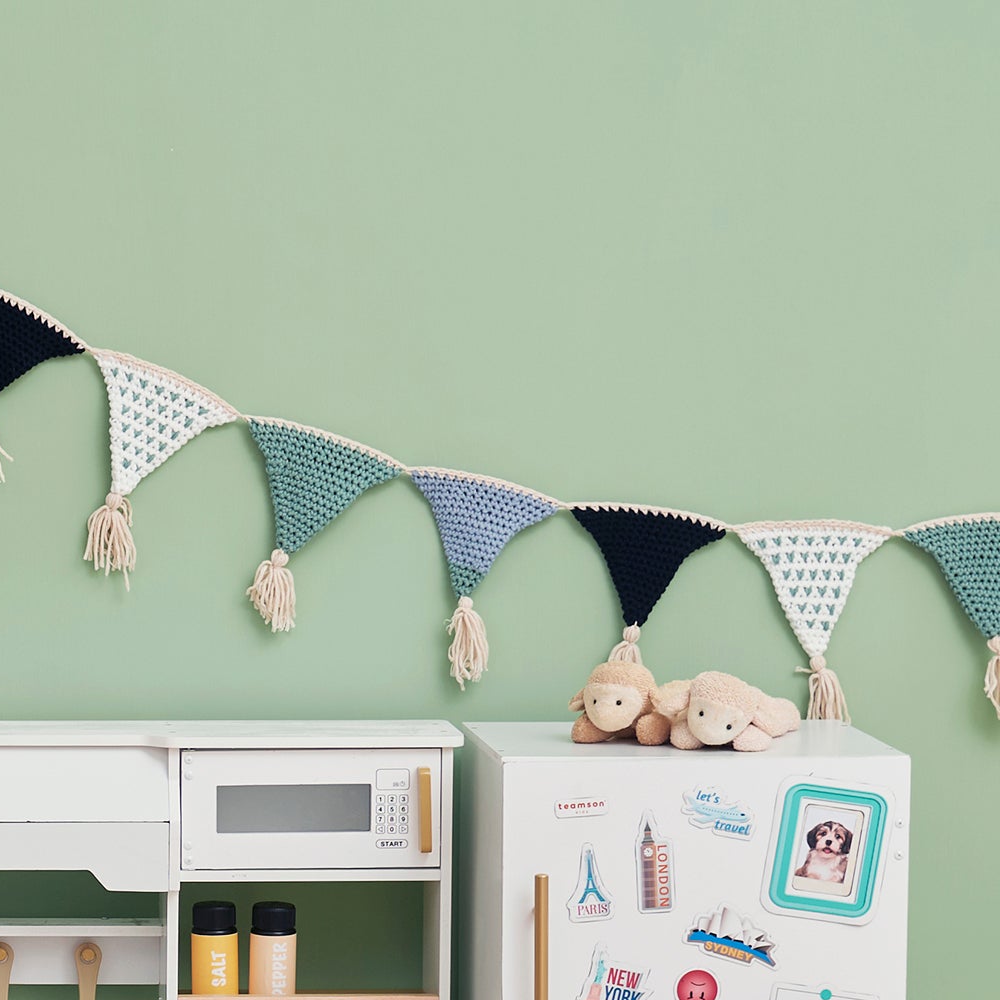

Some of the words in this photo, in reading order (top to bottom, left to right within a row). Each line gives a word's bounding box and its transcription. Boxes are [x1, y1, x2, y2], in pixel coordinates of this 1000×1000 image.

[558, 801, 605, 811] teamson
[696, 790, 720, 804] let's
[714, 819, 750, 836] travel
[657, 844, 670, 908] LONDON
[577, 903, 608, 916] PARIS
[704, 940, 754, 962] SYDNEY
[211, 950, 226, 987] SALT
[271, 942, 288, 996] PEPPER
[607, 967, 641, 989] NEW
